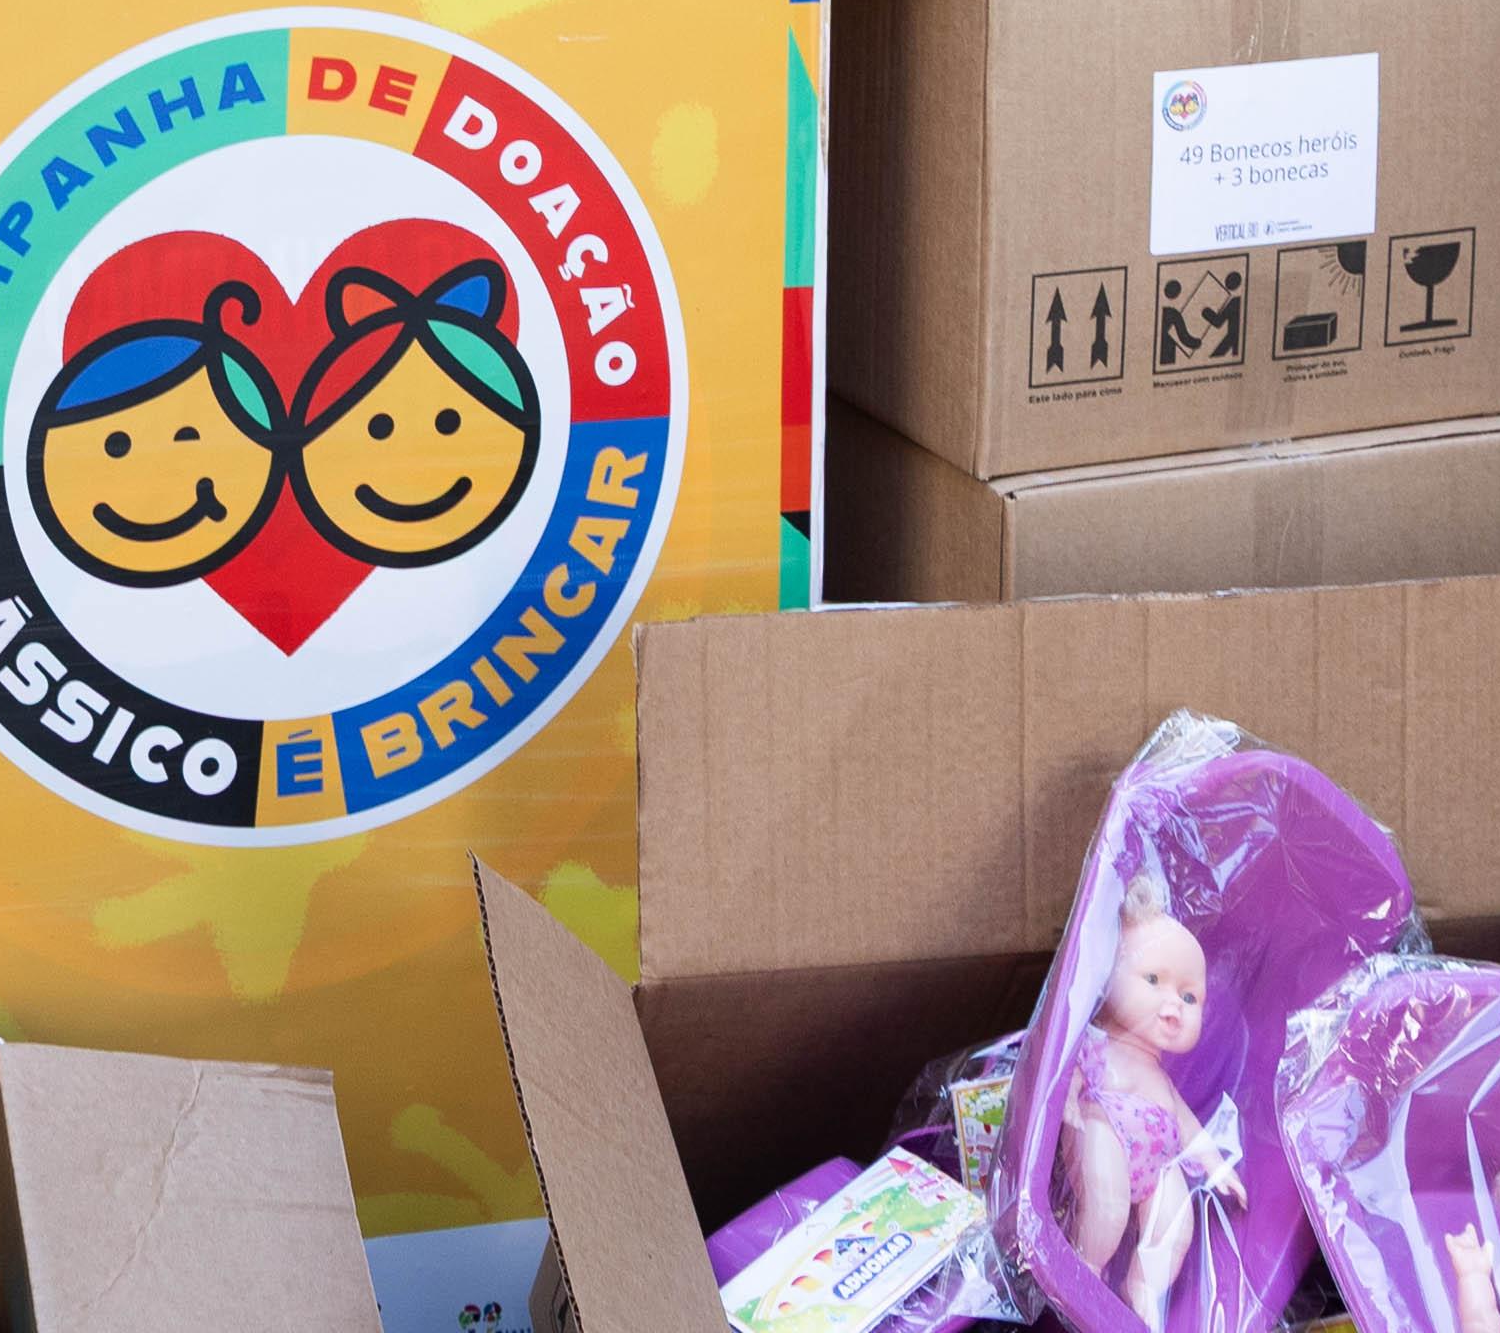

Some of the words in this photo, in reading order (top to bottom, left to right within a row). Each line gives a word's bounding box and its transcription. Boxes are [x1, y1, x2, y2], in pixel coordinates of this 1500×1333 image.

[1179, 145, 1204, 165] 49
[1209, 139, 1293, 163] Bonecos
[1298, 130, 1359, 156] heróis
[1231, 166, 1243, 187] 3
[1248, 161, 1330, 185] bonecas
[306, 56, 419, 116] DE
[442, 94, 638, 387] DOAÇÃO
[1075, 390, 1098, 401] para
[275, 729, 325, 798] É
[360, 444, 649, 780] BRINCAR
